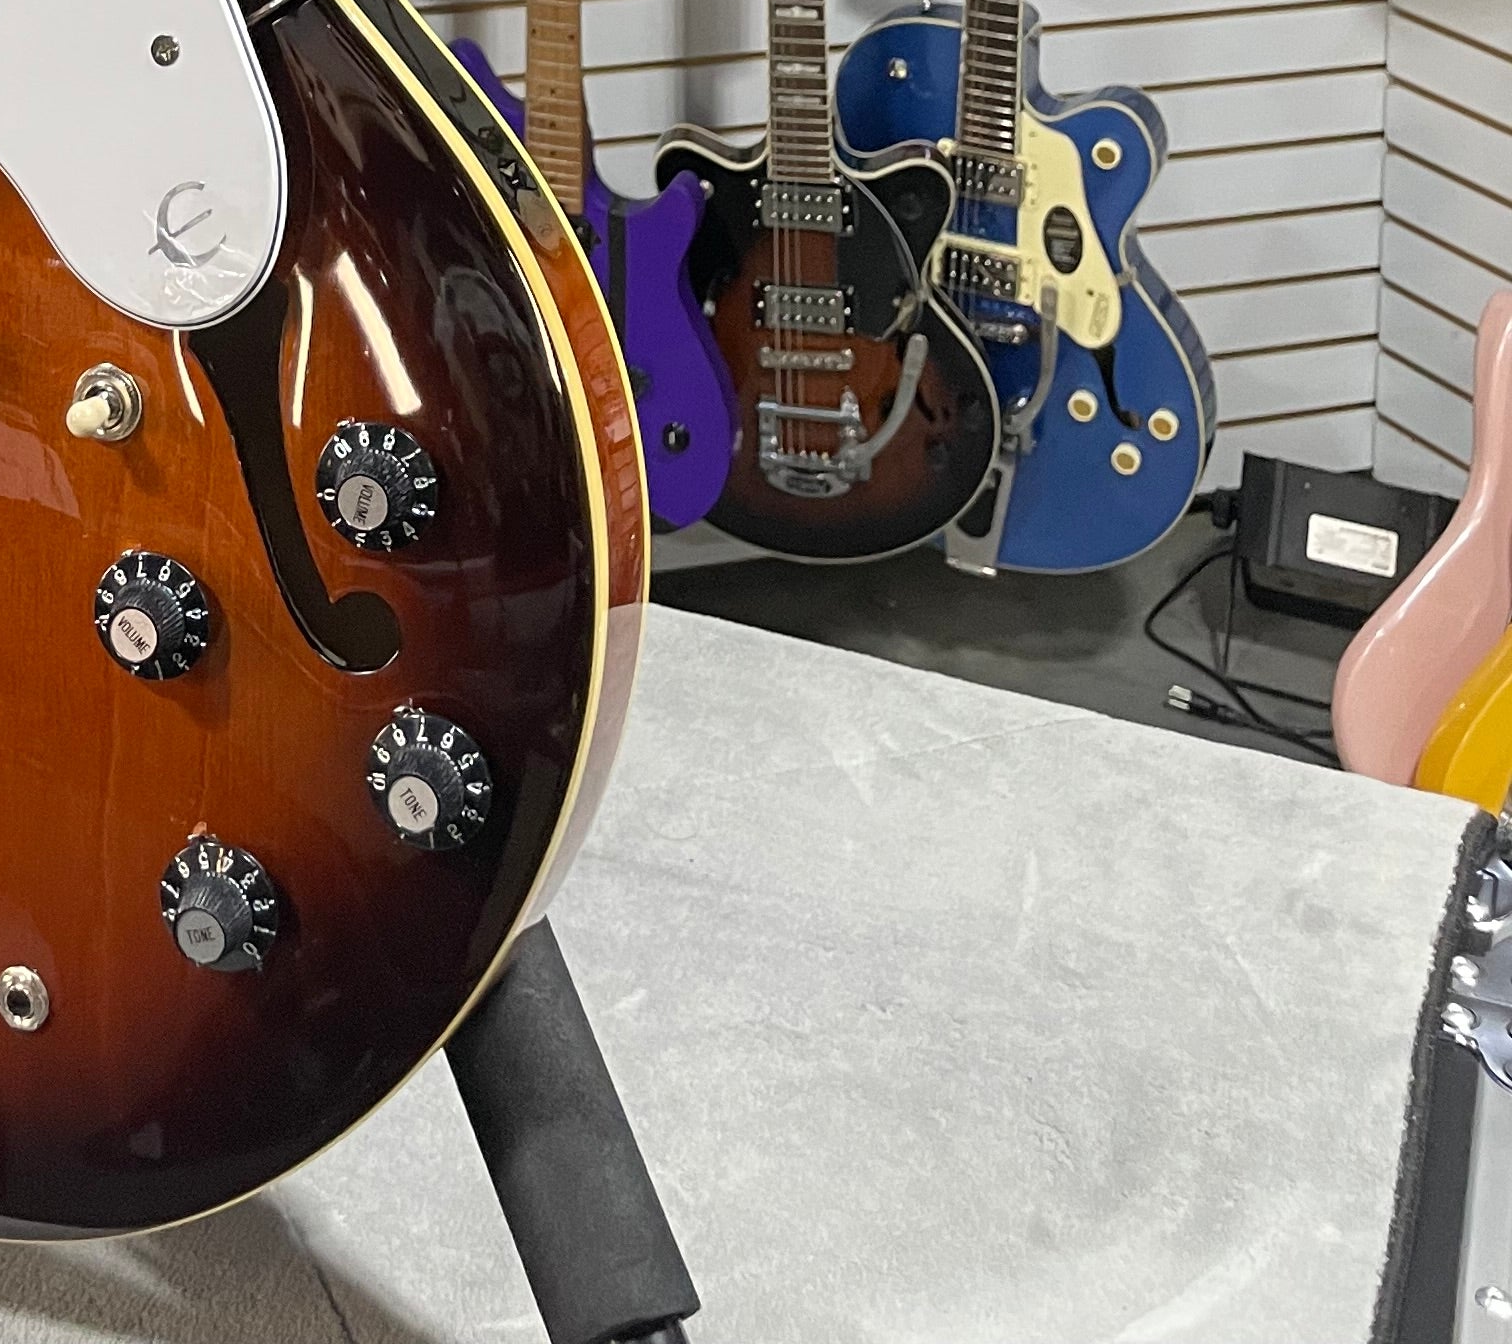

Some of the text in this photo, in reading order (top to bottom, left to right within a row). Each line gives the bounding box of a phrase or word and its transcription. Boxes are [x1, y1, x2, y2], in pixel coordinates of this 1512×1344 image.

[353, 484, 375, 526] VOLUME
[117, 615, 152, 655] VOLUME
[399, 788, 428, 822] TONE
[186, 926, 217, 945] TONE
